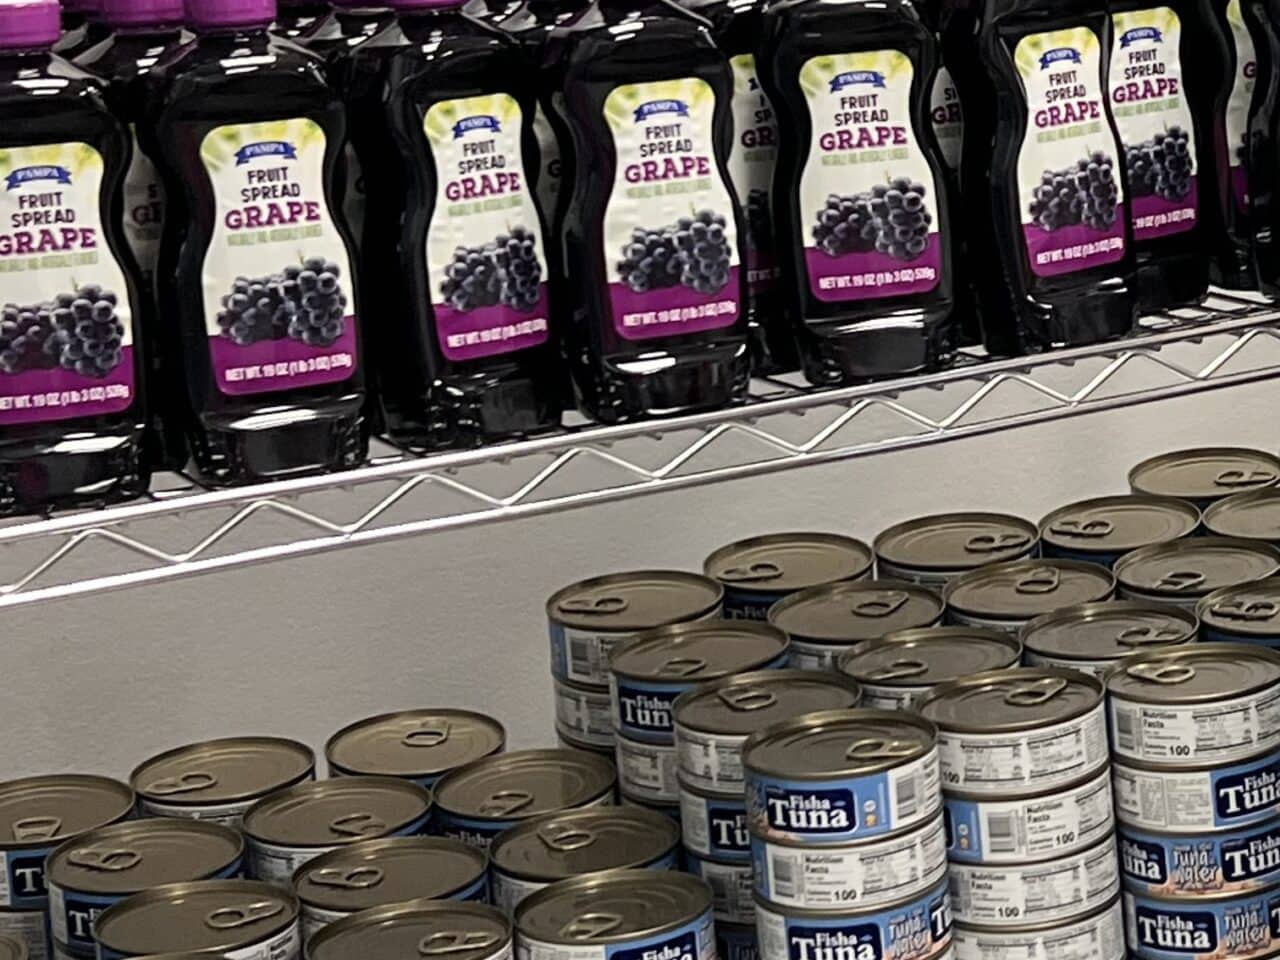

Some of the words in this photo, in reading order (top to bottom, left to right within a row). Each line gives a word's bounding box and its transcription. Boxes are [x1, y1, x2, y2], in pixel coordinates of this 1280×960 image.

[1129, 49, 1157, 64] FRUIT
[1049, 71, 1077, 86] FRUIT
[1125, 64, 1165, 80] SPREAD
[1046, 84, 1086, 103] SPREAD
[1113, 78, 1178, 103] GRAPE
[841, 94, 878, 109] FRUIT
[835, 109, 888, 127] SPREAD
[1035, 101, 1100, 128] GRAPE
[646, 124, 682, 139] FRUIT
[820, 127, 907, 151] GRAPE
[463, 140, 495, 157] FRUIT
[640, 139, 692, 157] SPREAD
[459, 155, 505, 175] SPREAD
[625, 157, 710, 183] GRAPE
[248, 167, 288, 184] FRUIT
[241, 184, 300, 202] SPREAD
[446, 172, 520, 201] GRAPE
[19, 192, 62, 210] FRUIT
[12, 210, 75, 228] SPREAD
[225, 202, 320, 230] GRAPE
[0, 228, 96, 256] GRAPE
[622, 698, 669, 726] Tun
[1170, 745, 1190, 756] 100
[1244, 772, 1276, 790] Fisha
[790, 795, 831, 810] Fisha
[768, 797, 849, 828] Tuna
[713, 819, 750, 845] Tu
[1056, 832, 1075, 845] 100
[1250, 834, 1280, 852] Fisha
[1123, 856, 1161, 879] una
[834, 889, 856, 900] 100
[998, 907, 1019, 918] 100
[1139, 916, 1210, 948] Tuna
[1158, 916, 1193, 930] Fisha
[815, 932, 857, 946] Fisha
[792, 937, 875, 960] Tuna
